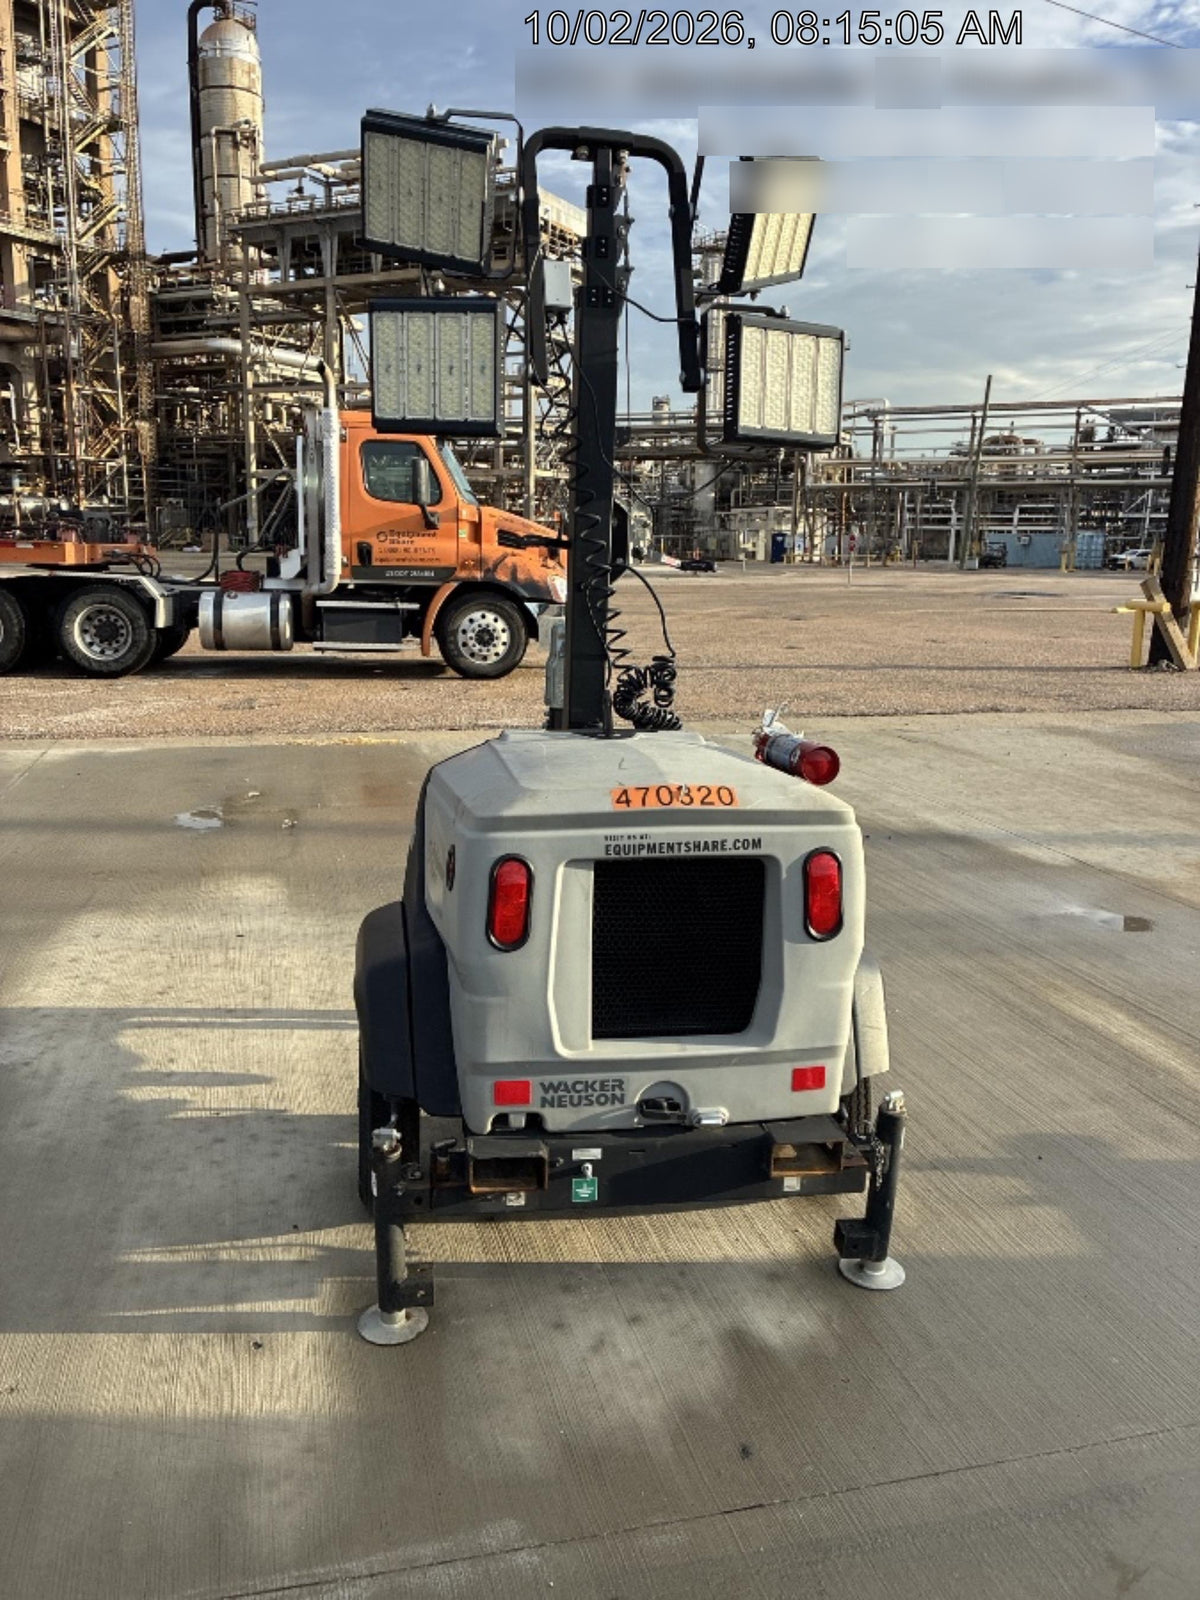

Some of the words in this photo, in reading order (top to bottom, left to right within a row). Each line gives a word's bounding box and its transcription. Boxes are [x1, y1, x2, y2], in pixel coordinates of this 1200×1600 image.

[604, 838, 762, 856] EQUIPMENTSHARE.COM
[539, 1078, 625, 1095] WACKER
[540, 1093, 626, 1108] NEUSON
